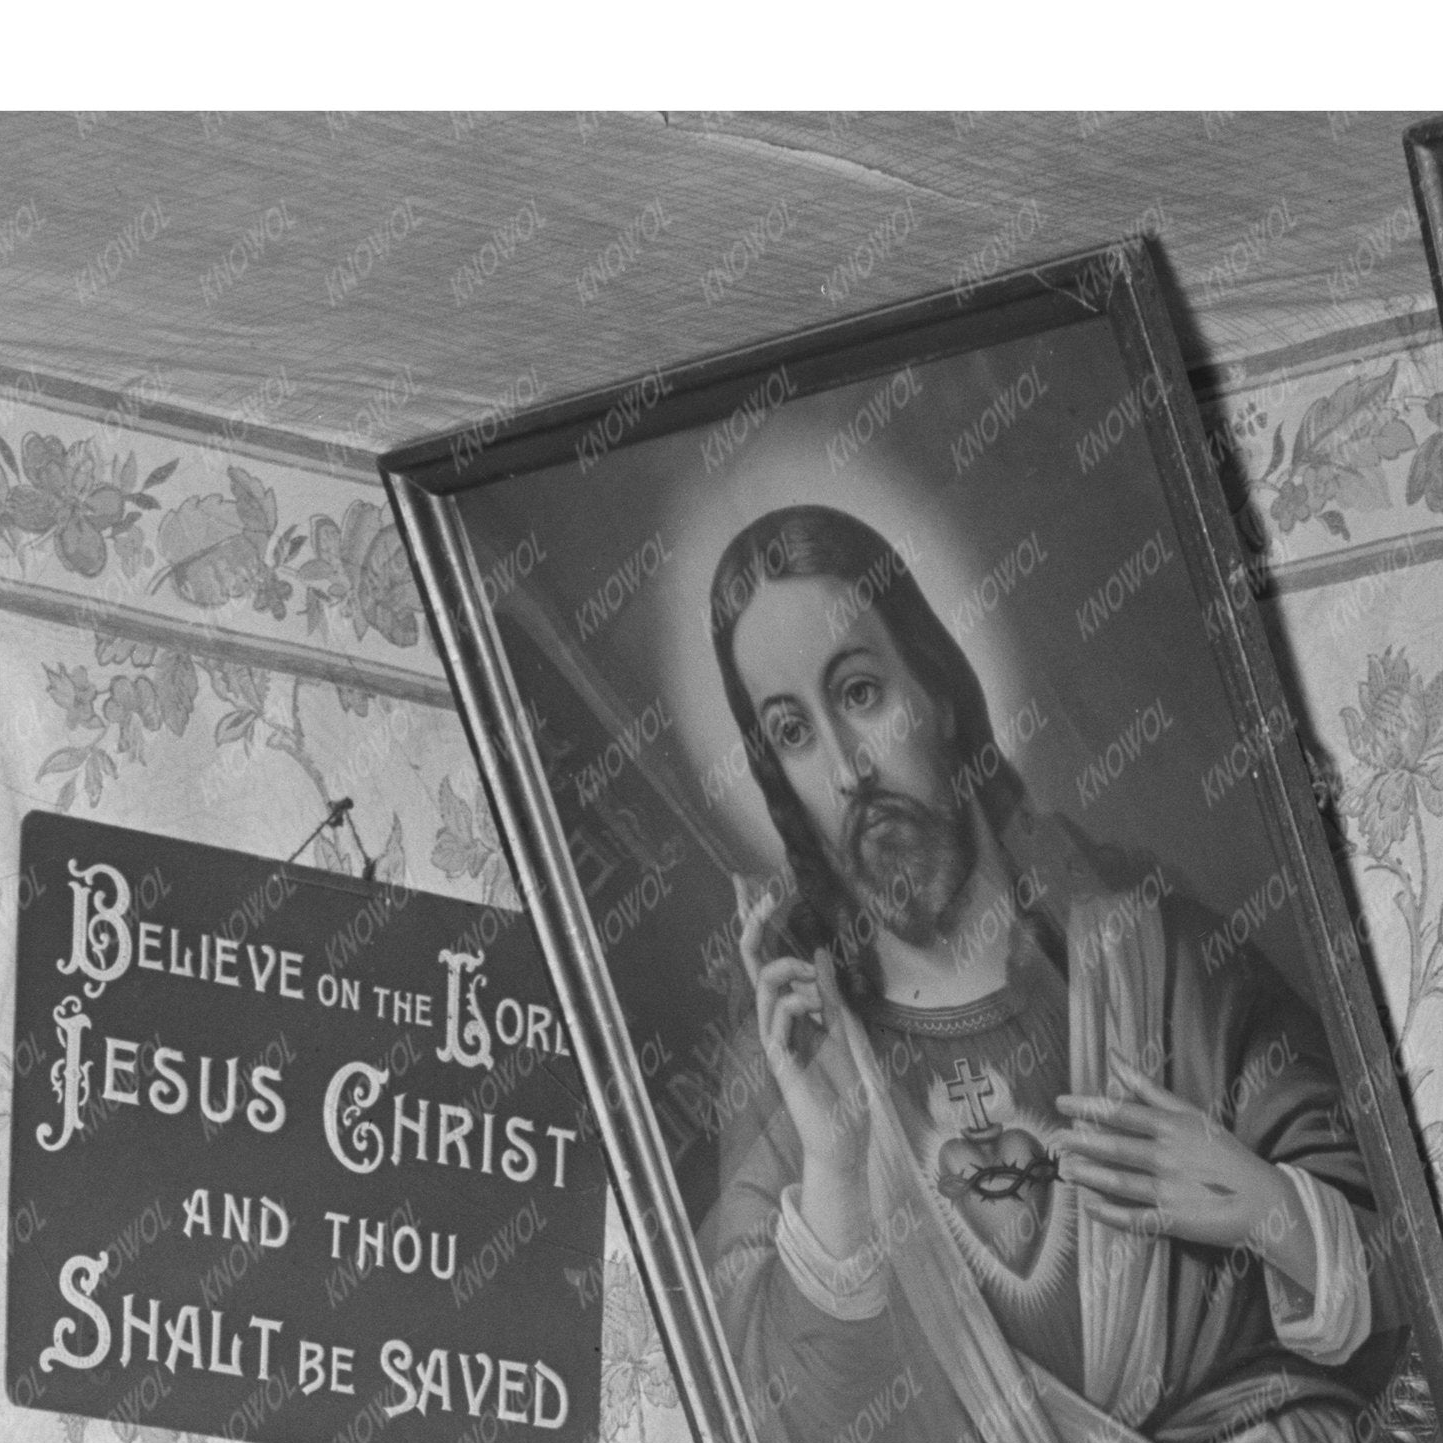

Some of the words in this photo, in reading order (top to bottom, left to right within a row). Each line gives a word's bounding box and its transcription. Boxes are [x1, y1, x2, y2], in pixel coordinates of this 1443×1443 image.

[57, 858, 304, 999] BELIEVE
[318, 974, 360, 1009] ON
[374, 987, 433, 1025] THE
[36, 996, 285, 1152] JESUS
[322, 1060, 578, 1188] CHRIST
[183, 1189, 290, 1248] AND
[324, 1211, 456, 1280] THOU
[39, 1250, 282, 1381] SHALT
[299, 1341, 354, 1395] BE
[380, 1339, 569, 1429] SAVED
